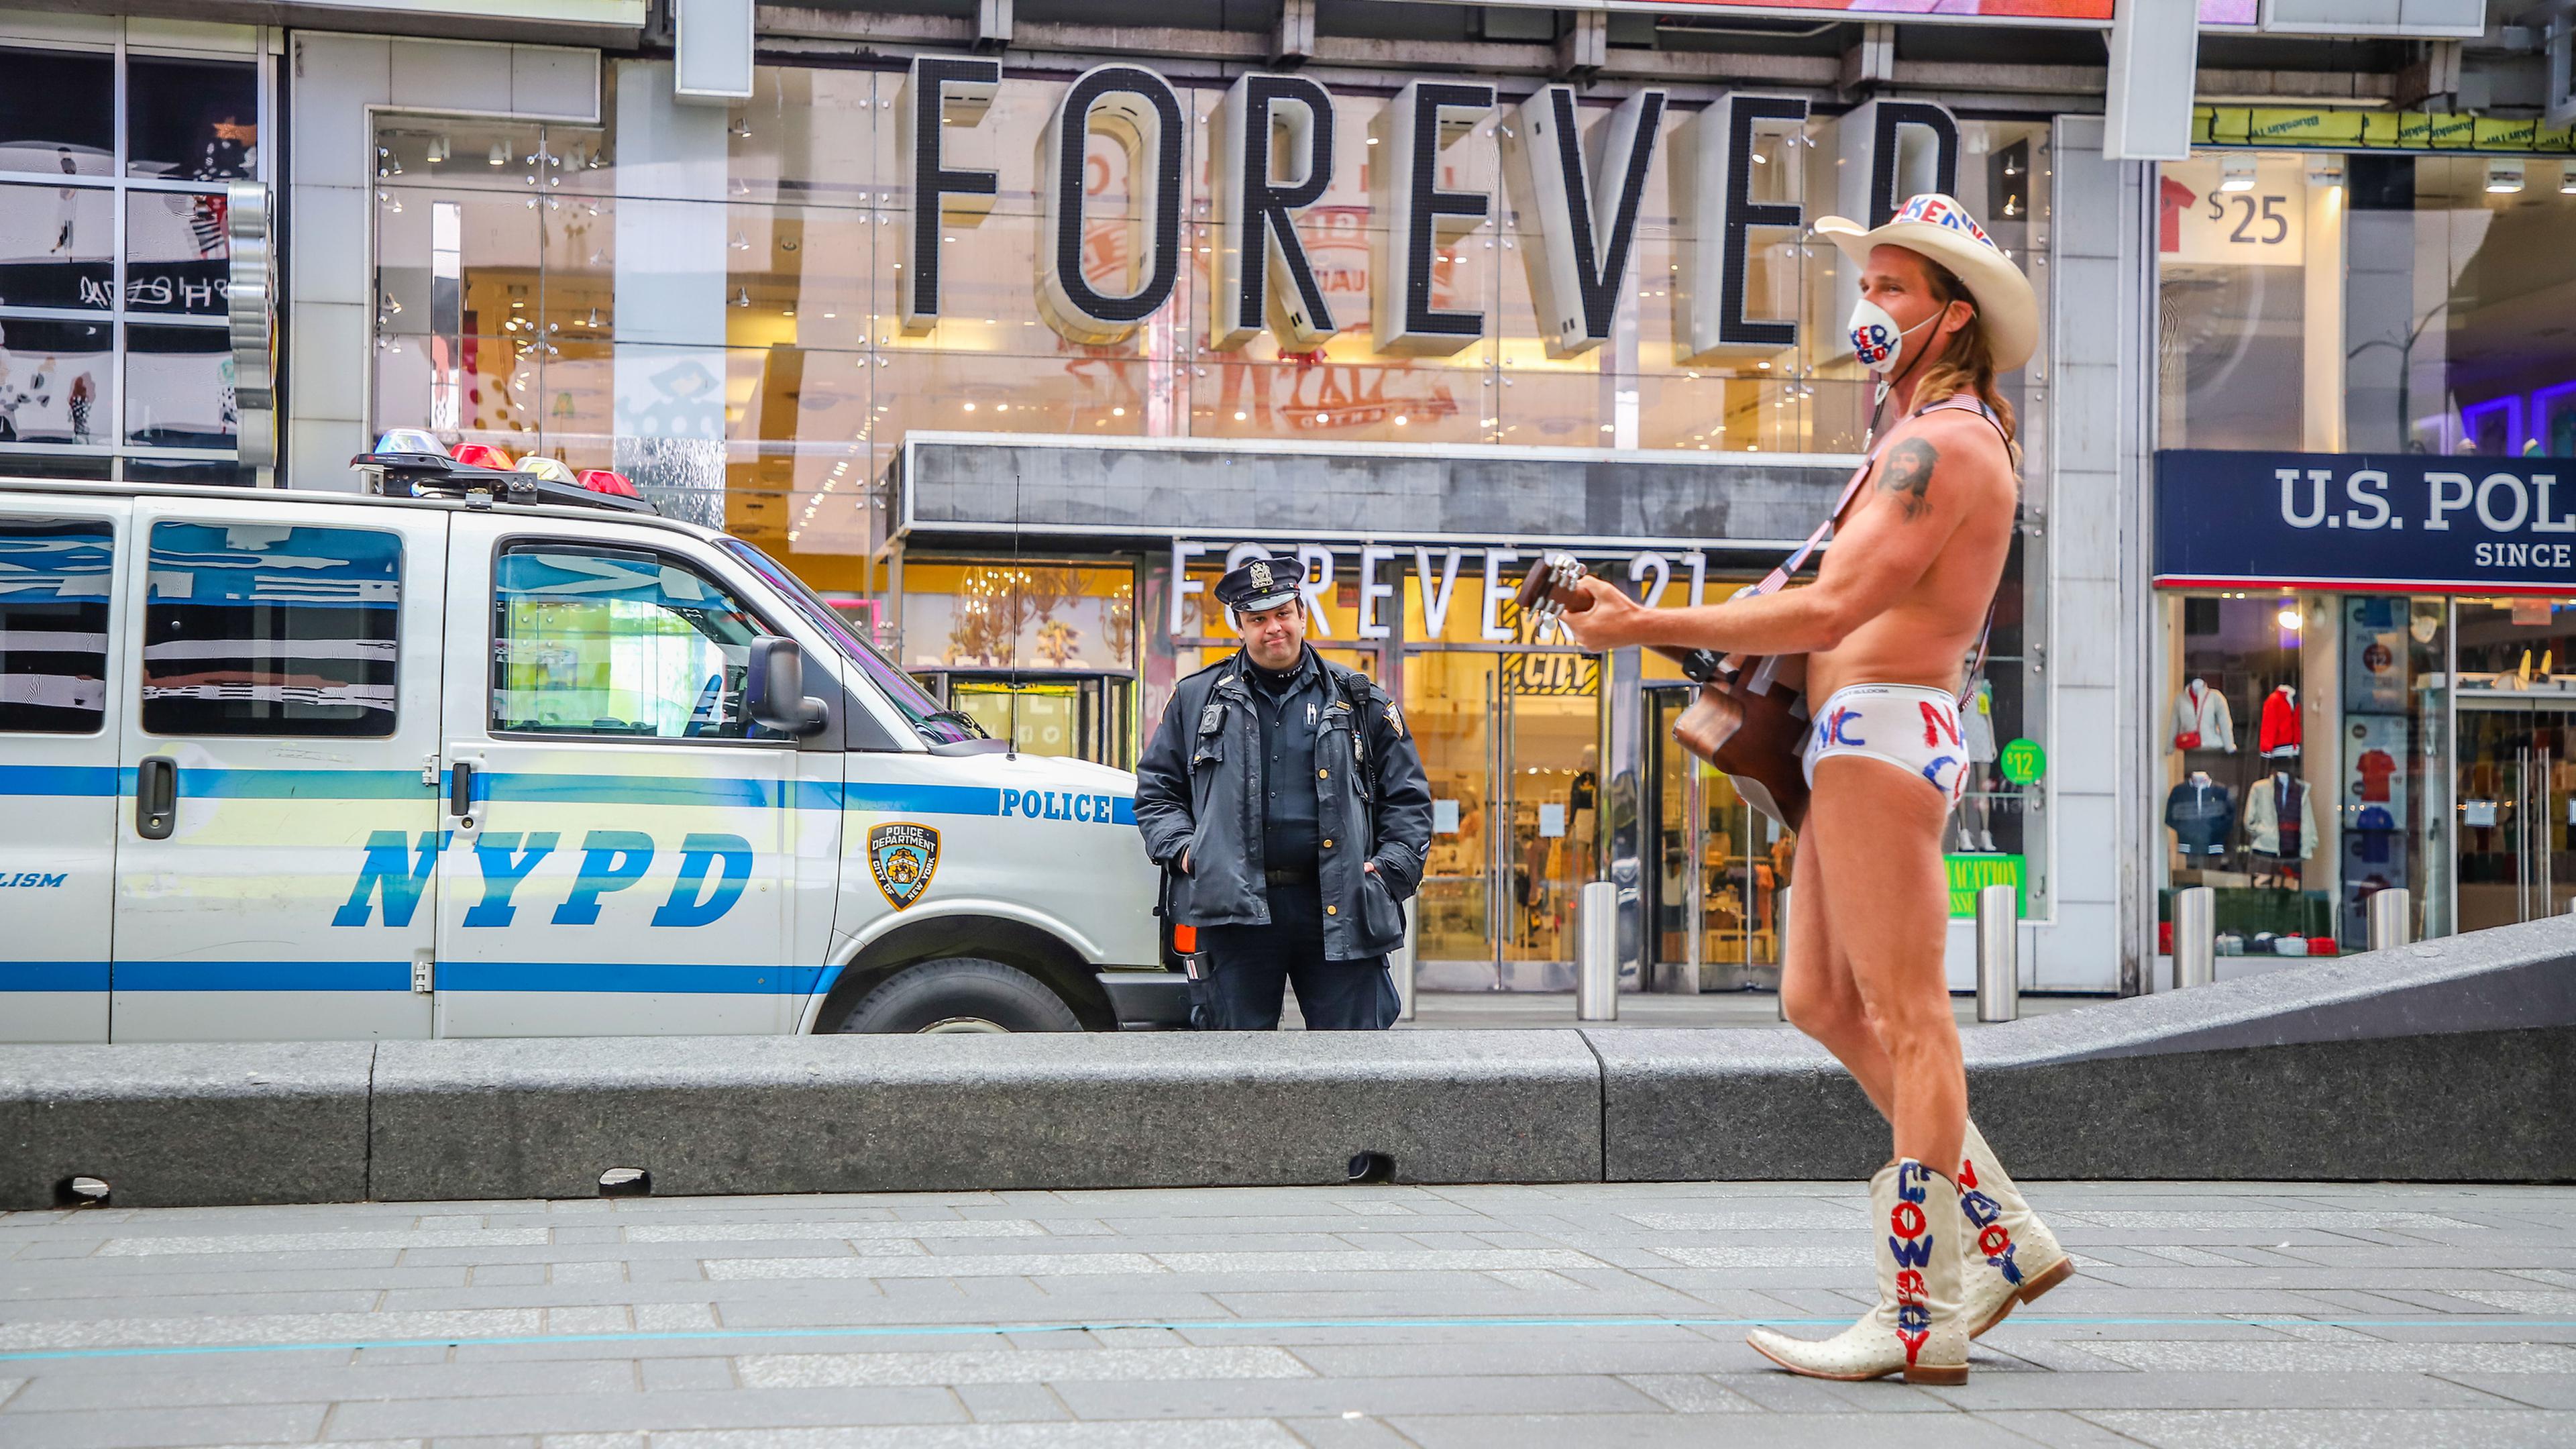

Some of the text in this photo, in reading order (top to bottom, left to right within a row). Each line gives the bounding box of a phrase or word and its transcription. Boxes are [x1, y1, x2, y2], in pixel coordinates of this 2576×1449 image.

[2208, 190, 2288, 244] $25
[2275, 468, 2576, 533] U.S. POL
[2475, 542, 2571, 568] SINCE
[1629, 549, 1707, 608] 21
[1523, 652, 1590, 687] CITY
[2007, 751, 2033, 775] $12
[1002, 788, 1110, 824] POLICE
[872, 835, 936, 853] DEPARTMENT
[886, 826, 924, 839] POLICE
[331, 830, 753, 928] NYPD
[872, 857, 936, 901] CITY OF NEW YORK
